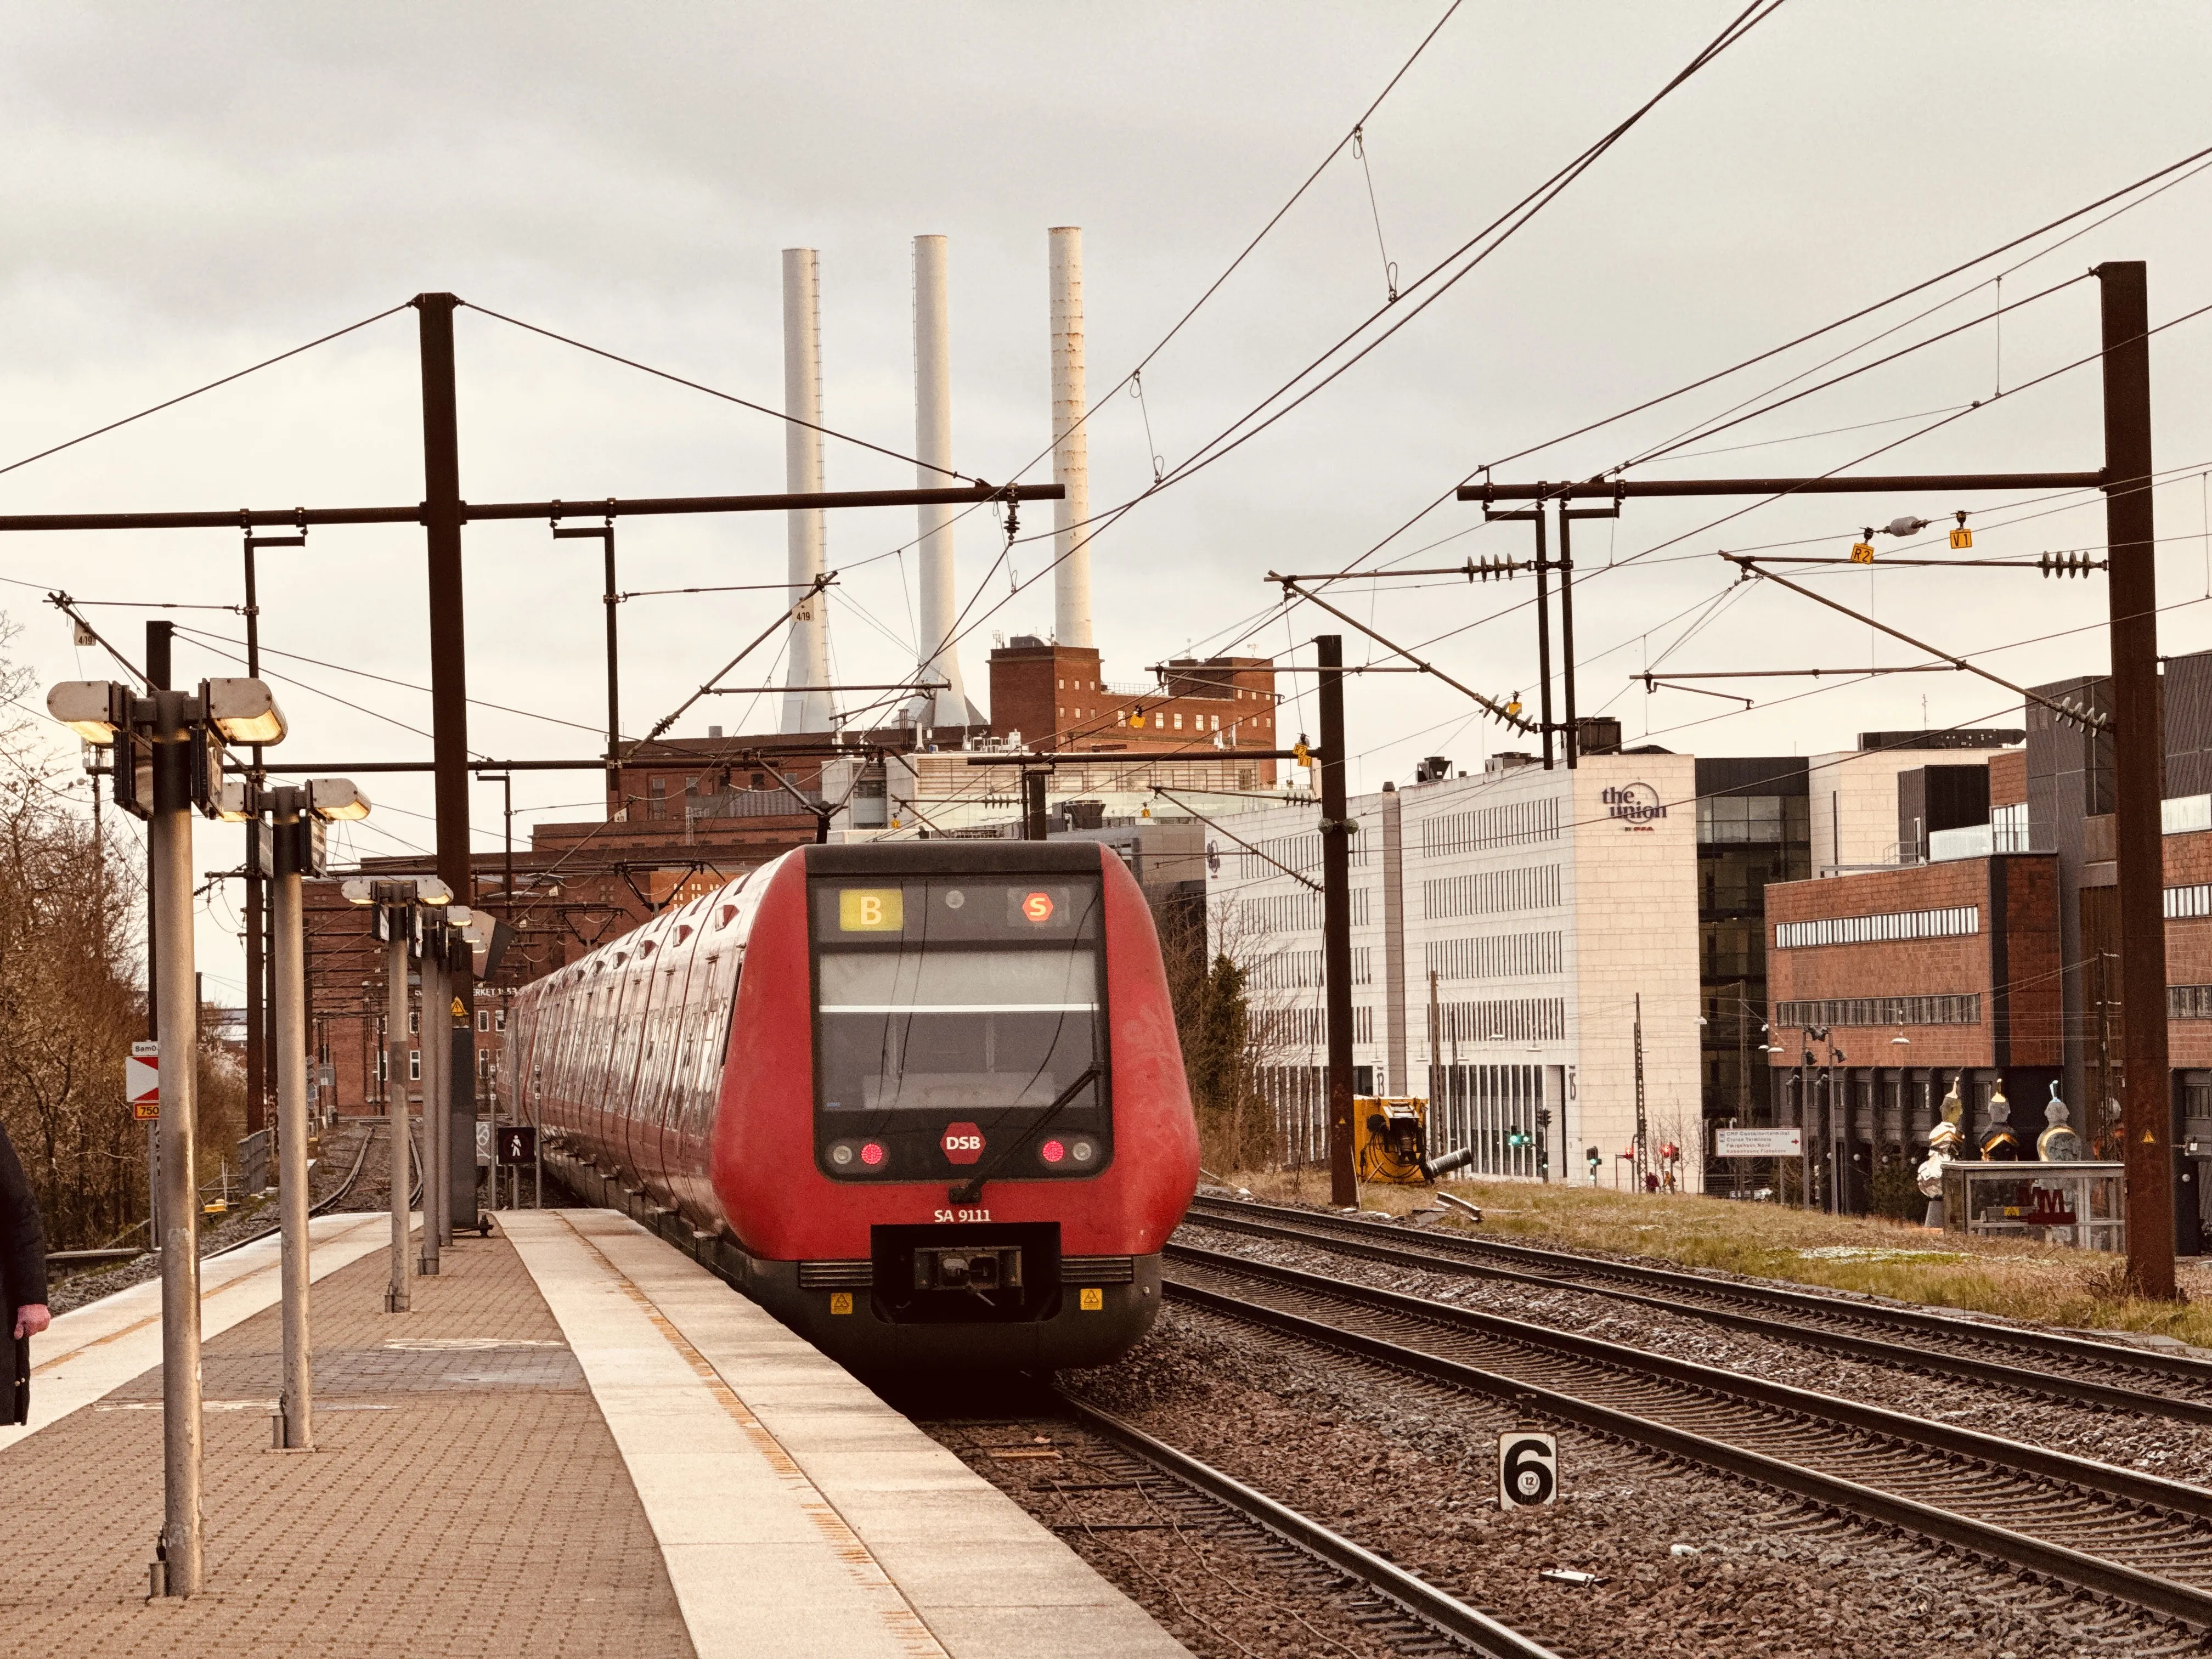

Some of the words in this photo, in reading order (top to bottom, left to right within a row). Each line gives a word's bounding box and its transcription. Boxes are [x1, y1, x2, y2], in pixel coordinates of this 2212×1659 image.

[1854, 548, 1870, 563] R2
[1601, 786, 1634, 804] the
[1610, 800, 1667, 819] union
[860, 896, 882, 924] B
[1029, 897, 1047, 916] S
[946, 1136, 980, 1150] DSB
[934, 1210, 954, 1223] SA
[958, 1209, 991, 1222] 9111
[1503, 1439, 1553, 1506] 6
[1525, 1476, 1534, 1486] 12
